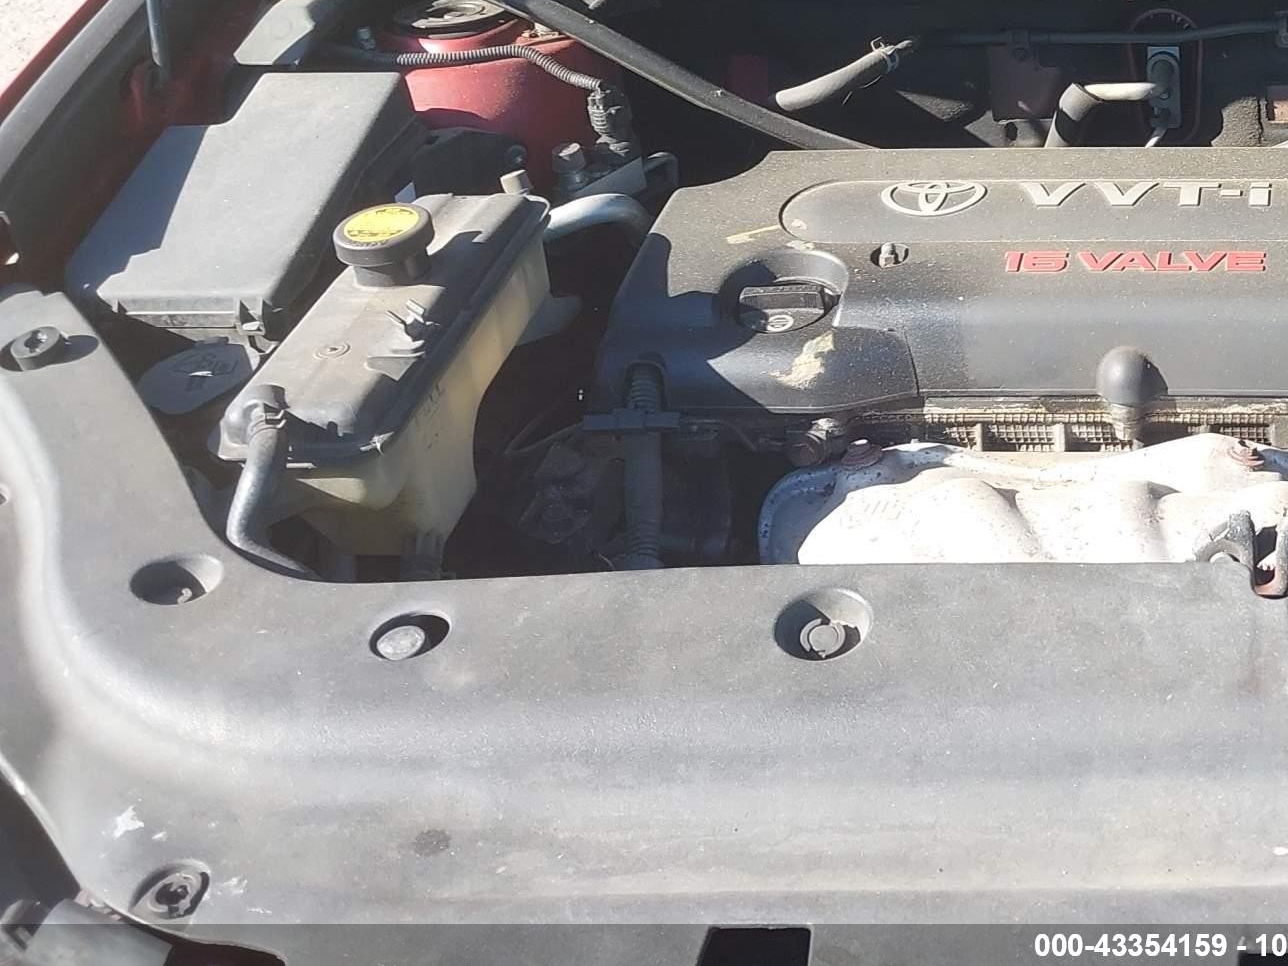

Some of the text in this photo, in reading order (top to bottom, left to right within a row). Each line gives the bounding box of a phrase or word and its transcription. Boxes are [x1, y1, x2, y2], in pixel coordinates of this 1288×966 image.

[1022, 181, 1273, 207] VVT-i
[1005, 249, 1267, 273] 16 VALVE
